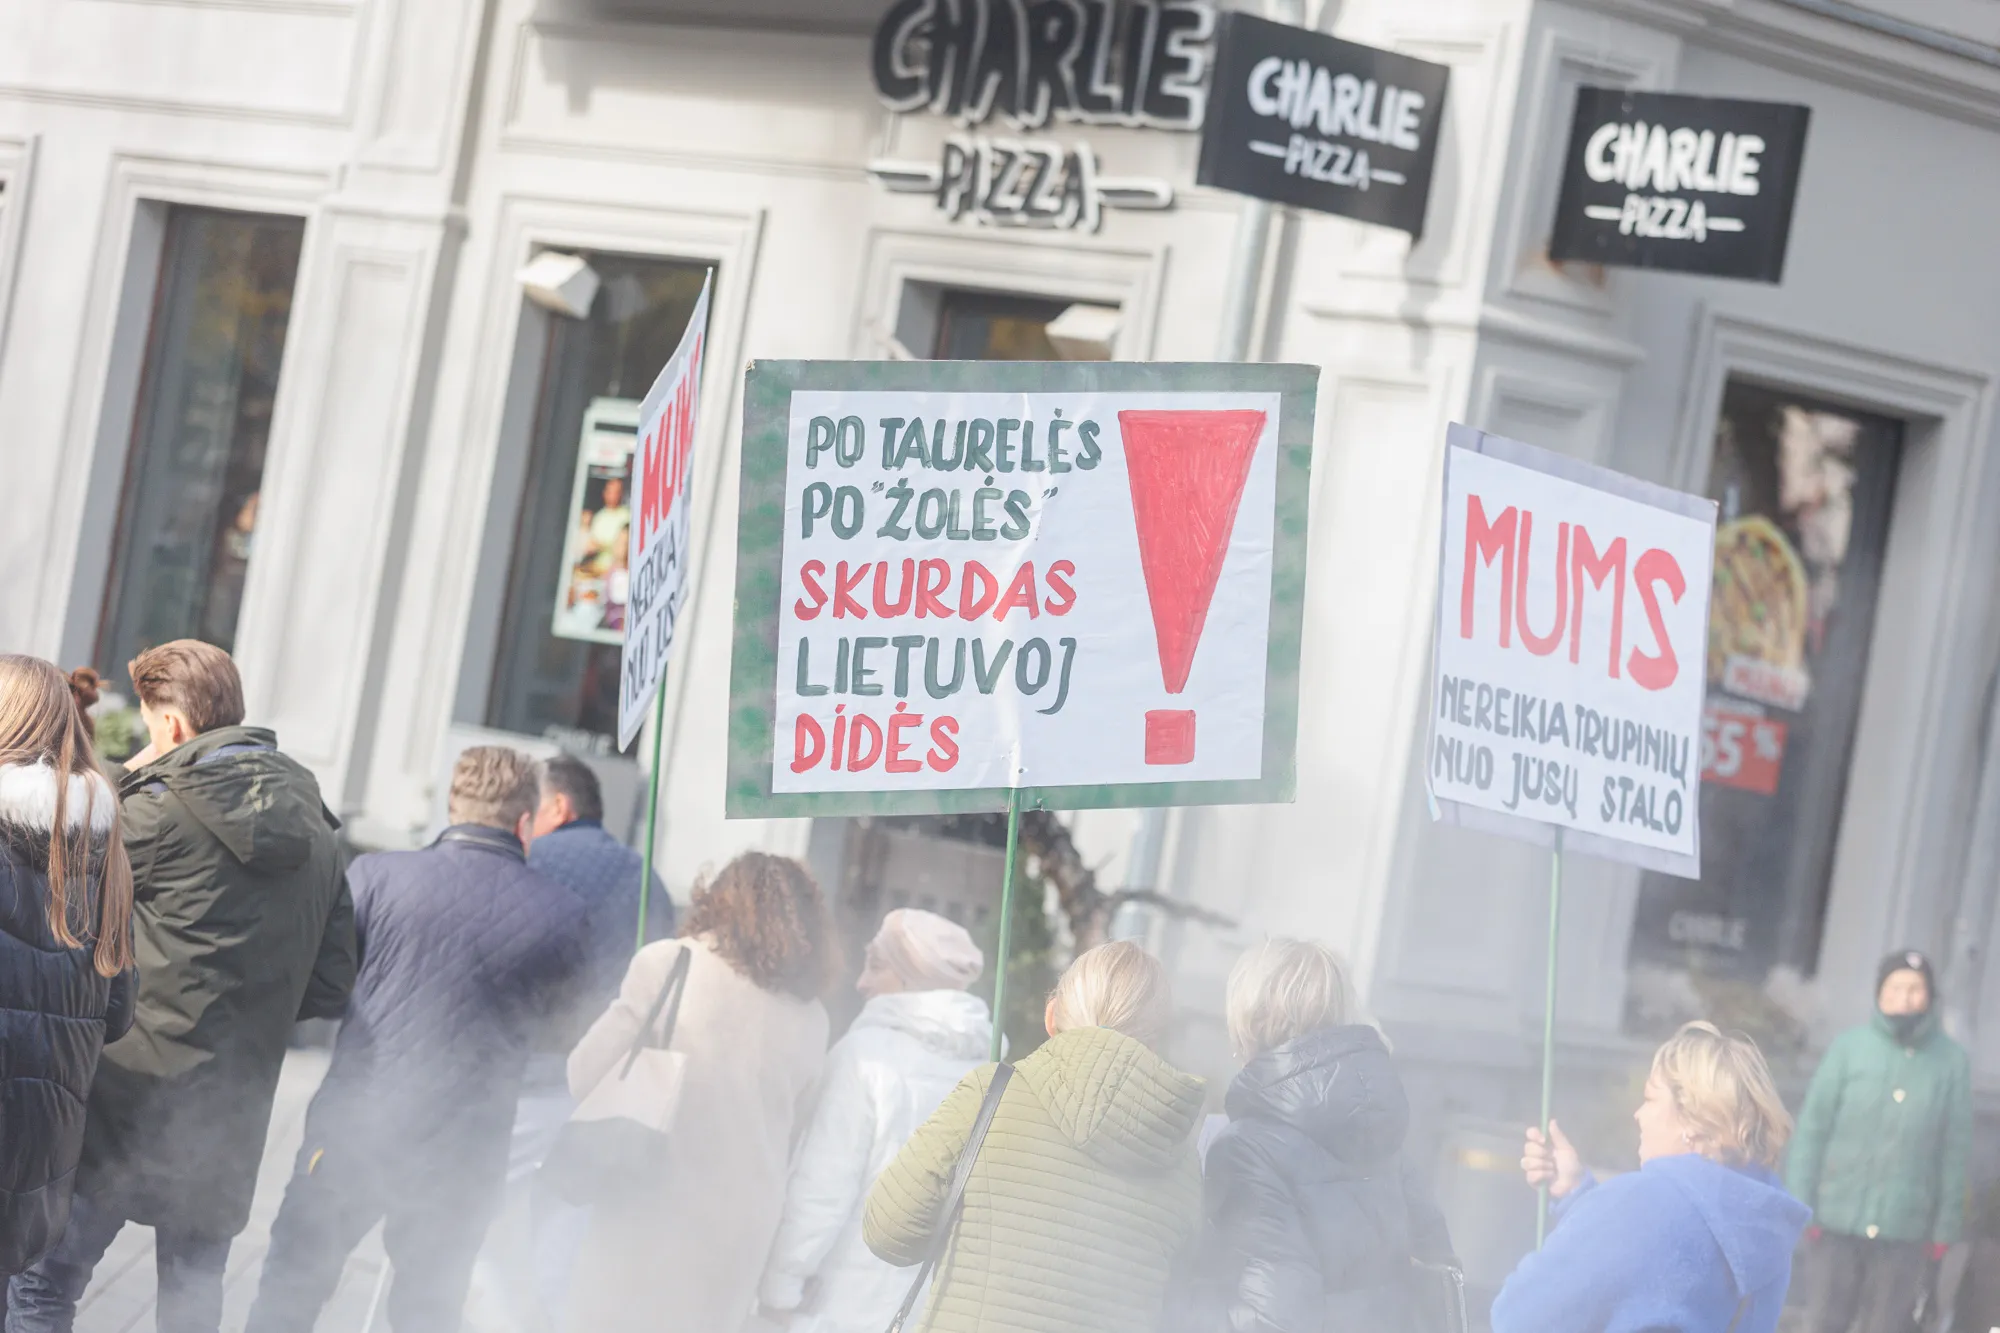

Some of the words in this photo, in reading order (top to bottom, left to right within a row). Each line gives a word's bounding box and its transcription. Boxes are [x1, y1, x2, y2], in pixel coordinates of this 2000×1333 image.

[872, 0, 1215, 131] CHARLIE
[1247, 56, 1425, 151] CHARLIE
[937, 134, 1103, 235] PIZZA
[1284, 133, 1370, 192] PIZZA
[1584, 119, 1766, 196] CHARLIE
[1618, 192, 1707, 243] PIZZA
[806, 416, 865, 470] PO
[879, 408, 1102, 474] TAURELĖS
[801, 481, 864, 540] PO
[794, 558, 1077, 621] SKURDAS
[1460, 493, 1687, 691] MUMS
[796, 635, 1077, 715] LIETUVOJ
[1440, 674, 1570, 748] NEREIKIA
[1575, 703, 1690, 790] TRUPINIŲ
[1434, 734, 1494, 790] NUO
[1600, 775, 1683, 836] STALO
